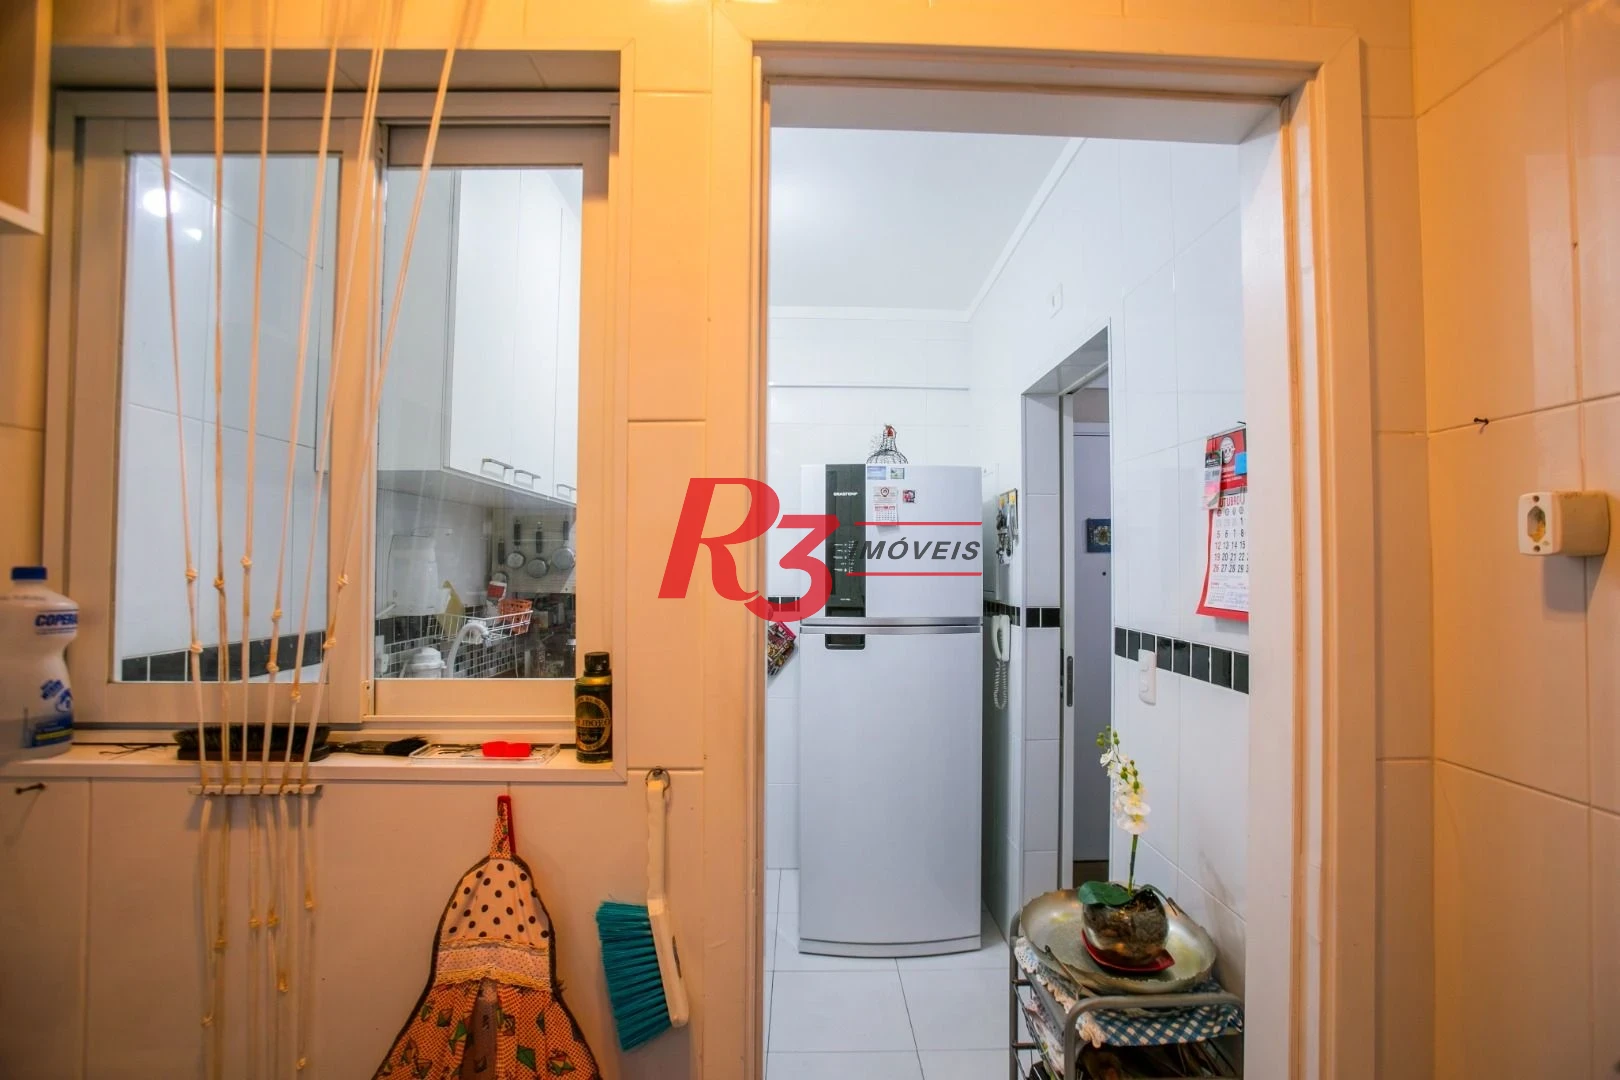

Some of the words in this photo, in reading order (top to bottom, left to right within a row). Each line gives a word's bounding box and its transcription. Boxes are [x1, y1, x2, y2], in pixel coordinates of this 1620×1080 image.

[1221, 552, 1229, 561] 20
[1239, 552, 1245, 561] 22
[1221, 564, 1227, 573] 27
